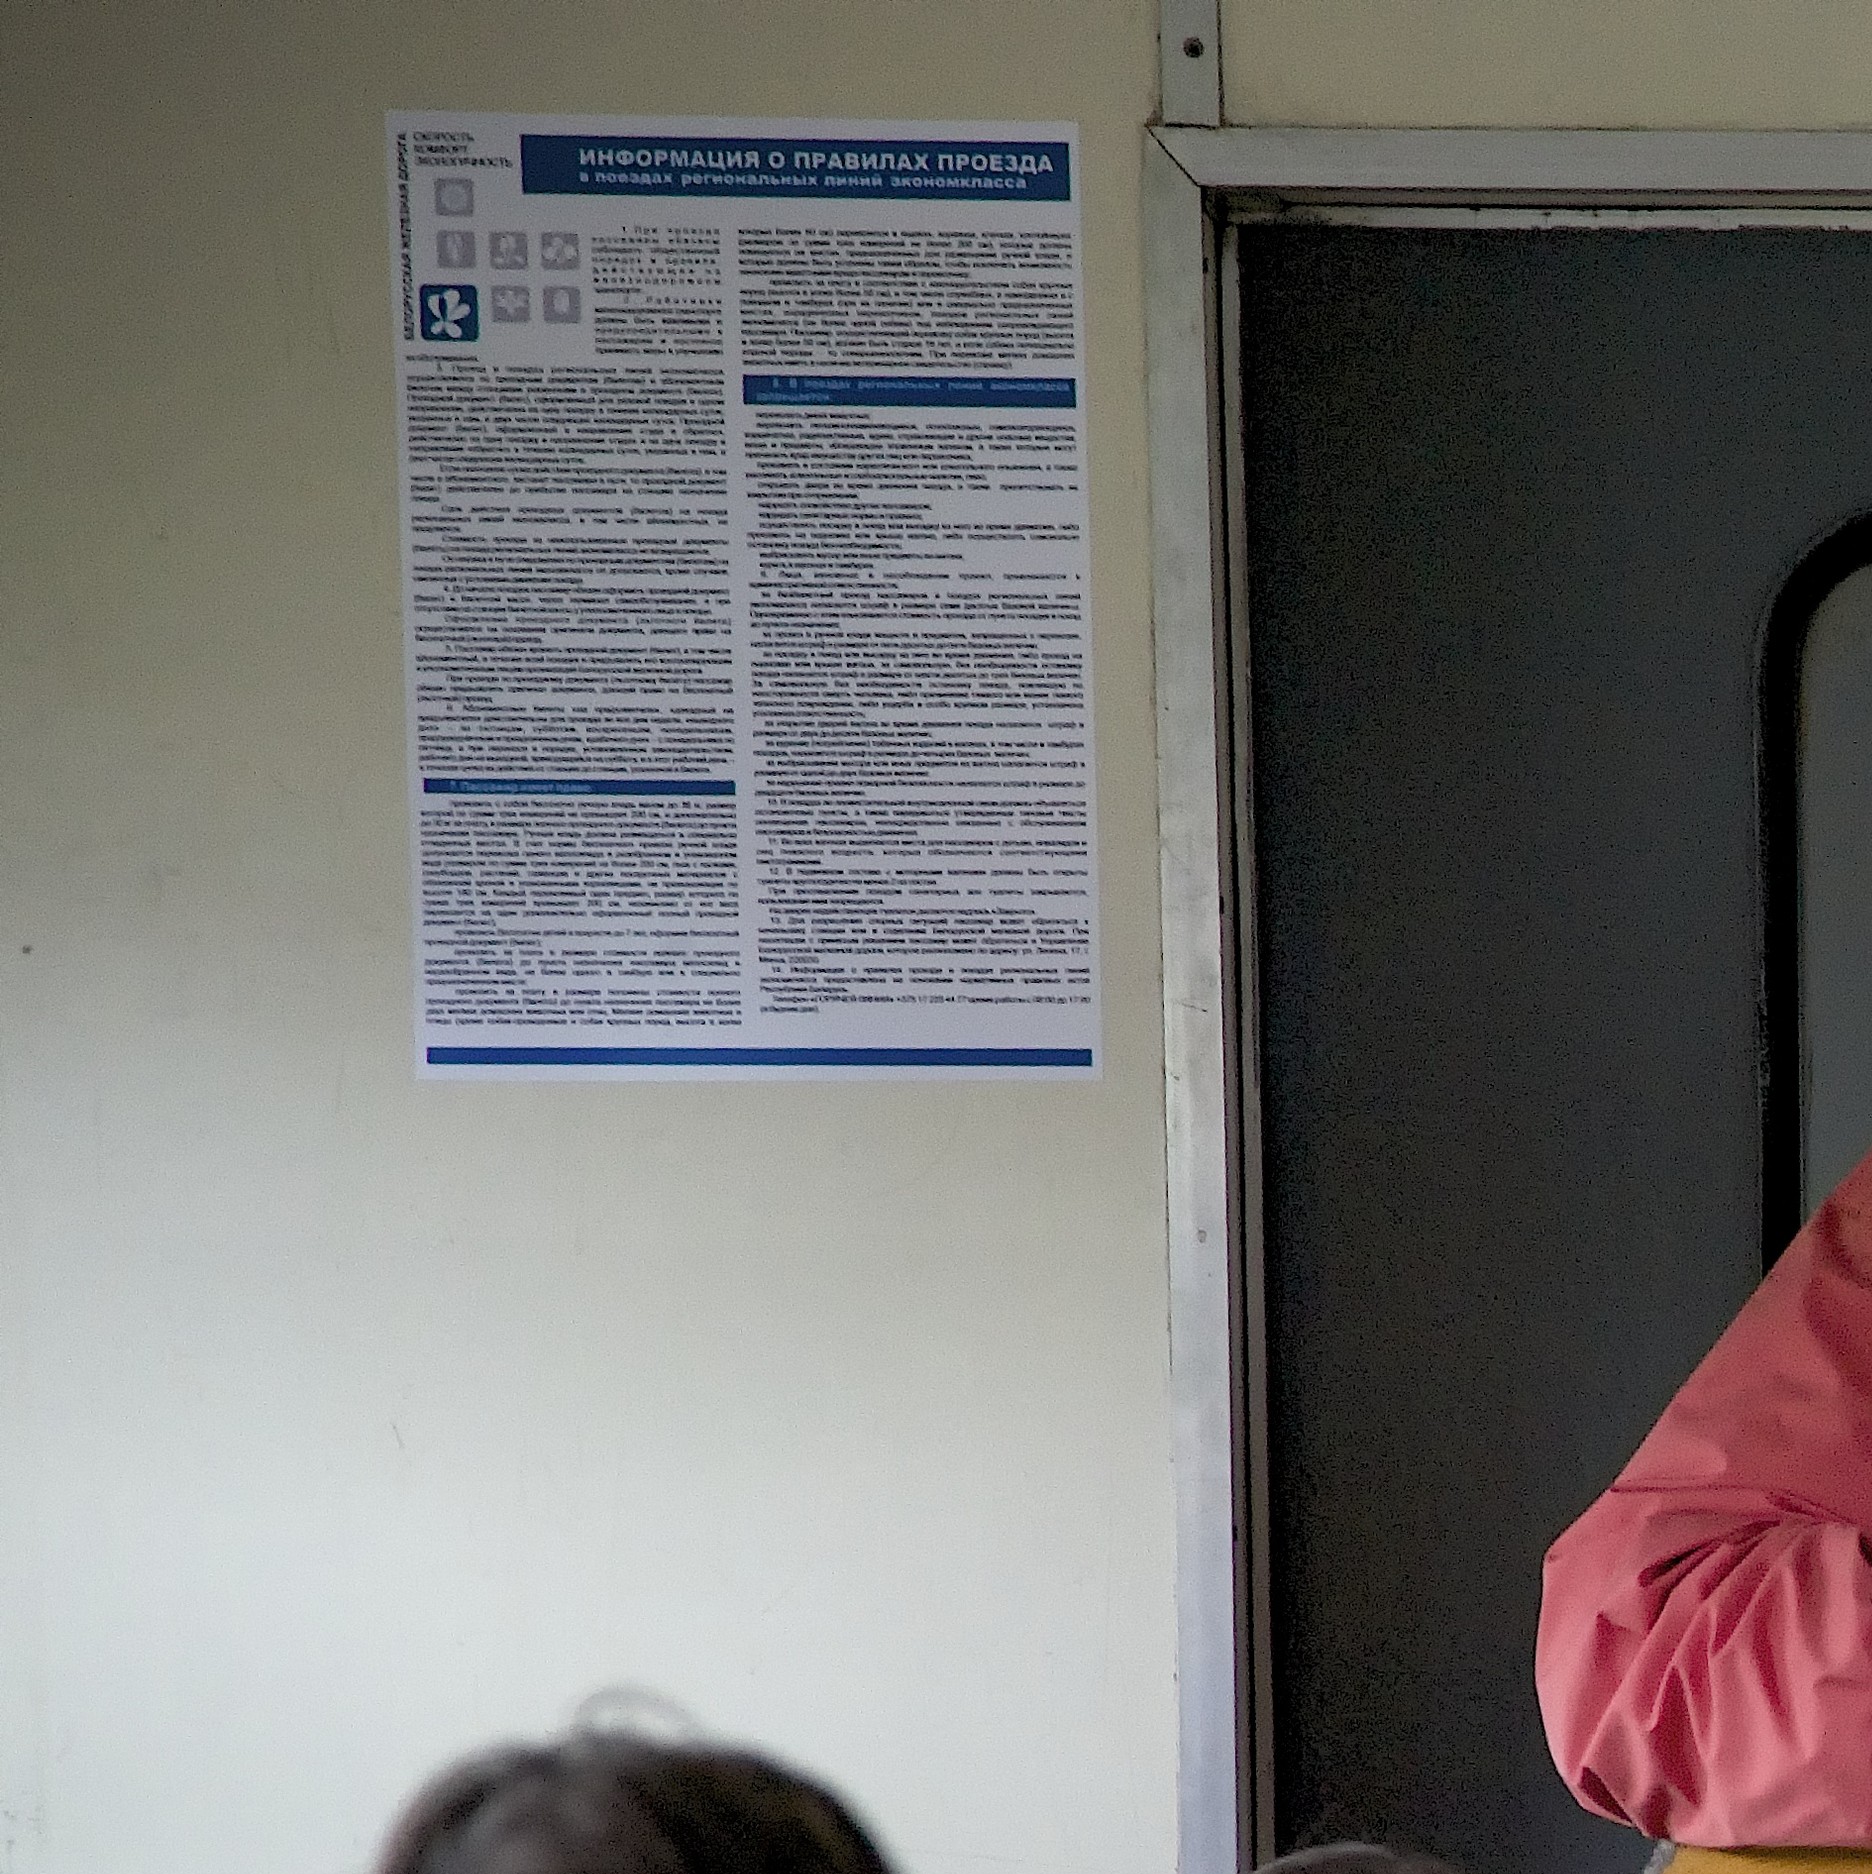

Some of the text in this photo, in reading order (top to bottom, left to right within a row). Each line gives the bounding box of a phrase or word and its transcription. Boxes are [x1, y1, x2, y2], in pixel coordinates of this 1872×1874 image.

[579, 148, 1054, 176] ИНФОРМАЦИЯ О ПРАВИЛАХ ПРОЕЗДА
[579, 172, 1027, 189] в поездах региональных линий экономкласса
